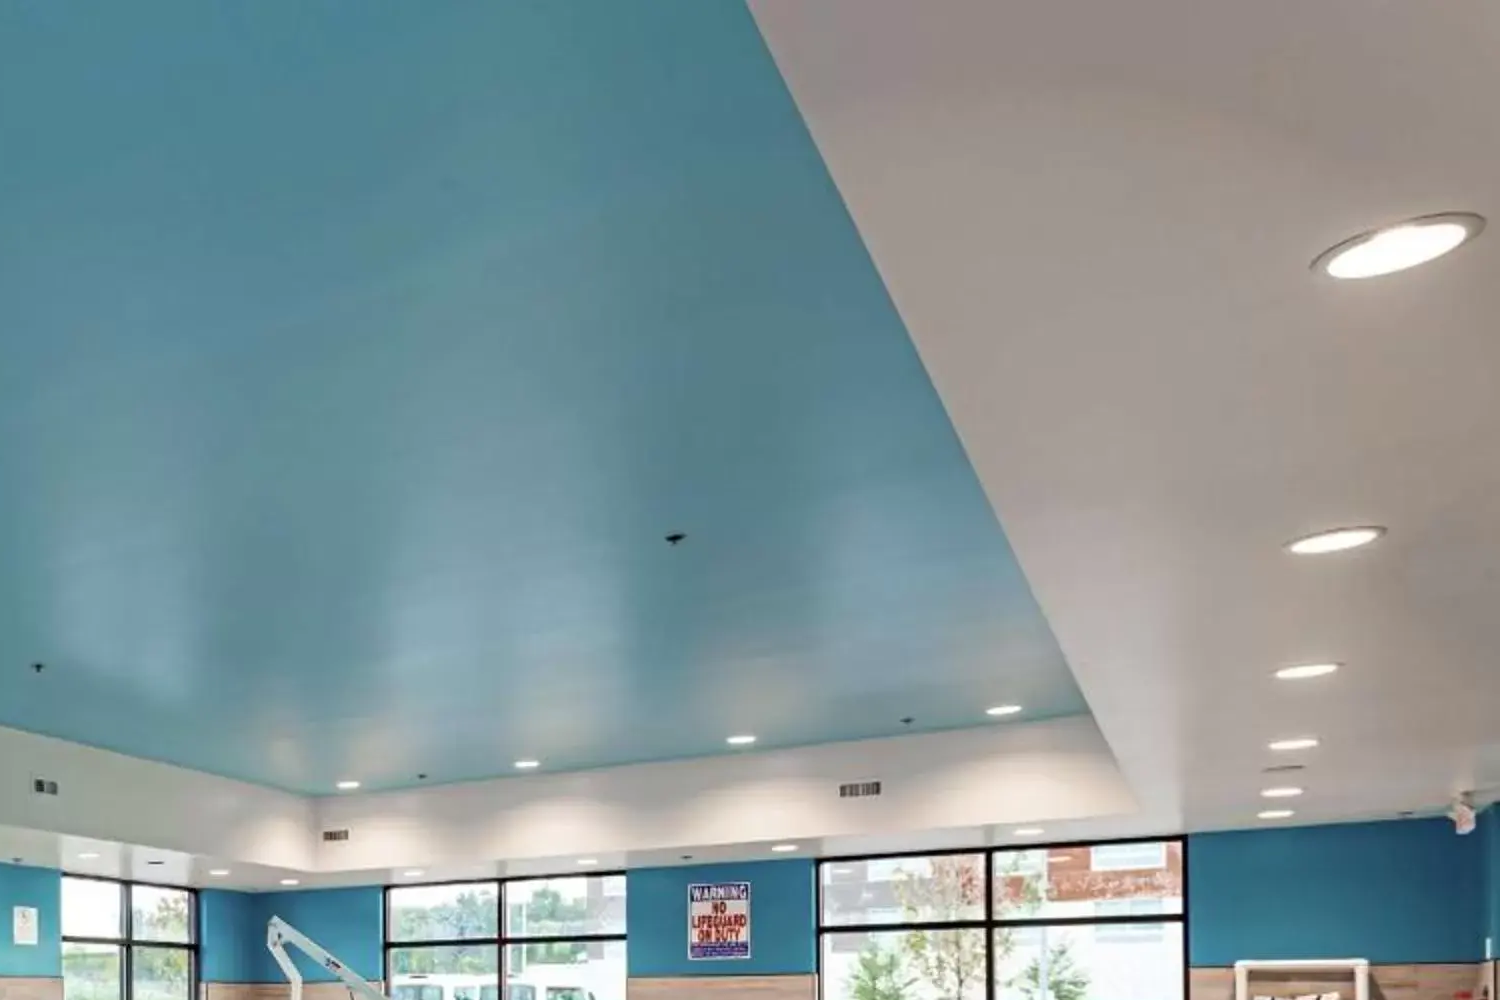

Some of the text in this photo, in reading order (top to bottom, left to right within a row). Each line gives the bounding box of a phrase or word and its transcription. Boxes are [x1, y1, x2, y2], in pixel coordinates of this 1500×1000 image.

[691, 885, 747, 901] WARNING
[712, 901, 727, 914] NO
[692, 914, 746, 929] LIFEGUARD
[697, 927, 740, 942] ON DUTY
